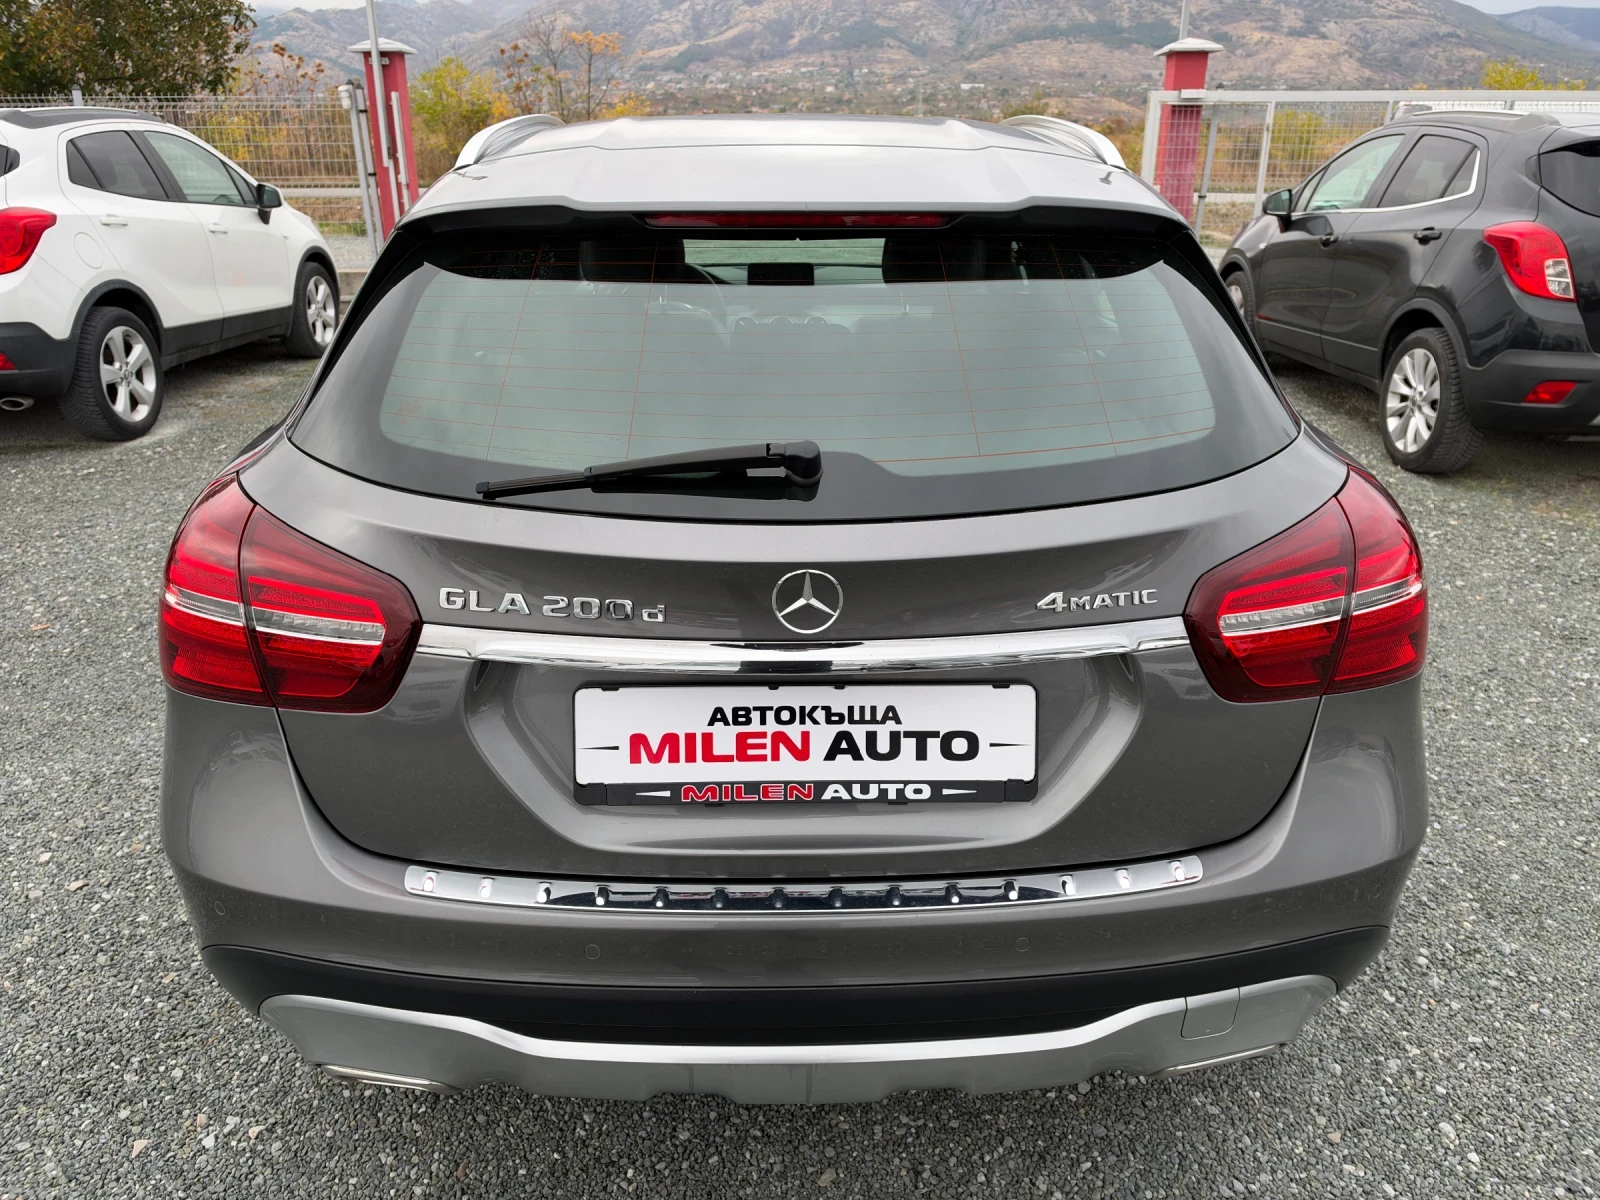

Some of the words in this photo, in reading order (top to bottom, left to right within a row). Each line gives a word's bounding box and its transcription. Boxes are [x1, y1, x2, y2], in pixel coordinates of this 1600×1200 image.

[439, 587, 531, 615] GLA
[542, 595, 634, 621] 200
[641, 604, 666, 623] d
[1036, 589, 1158, 612] 4MATIC
[629, 730, 811, 764] MILEN
[823, 729, 980, 762] AUTO
[681, 783, 814, 802] MILEN
[820, 783, 932, 800] AUTO
